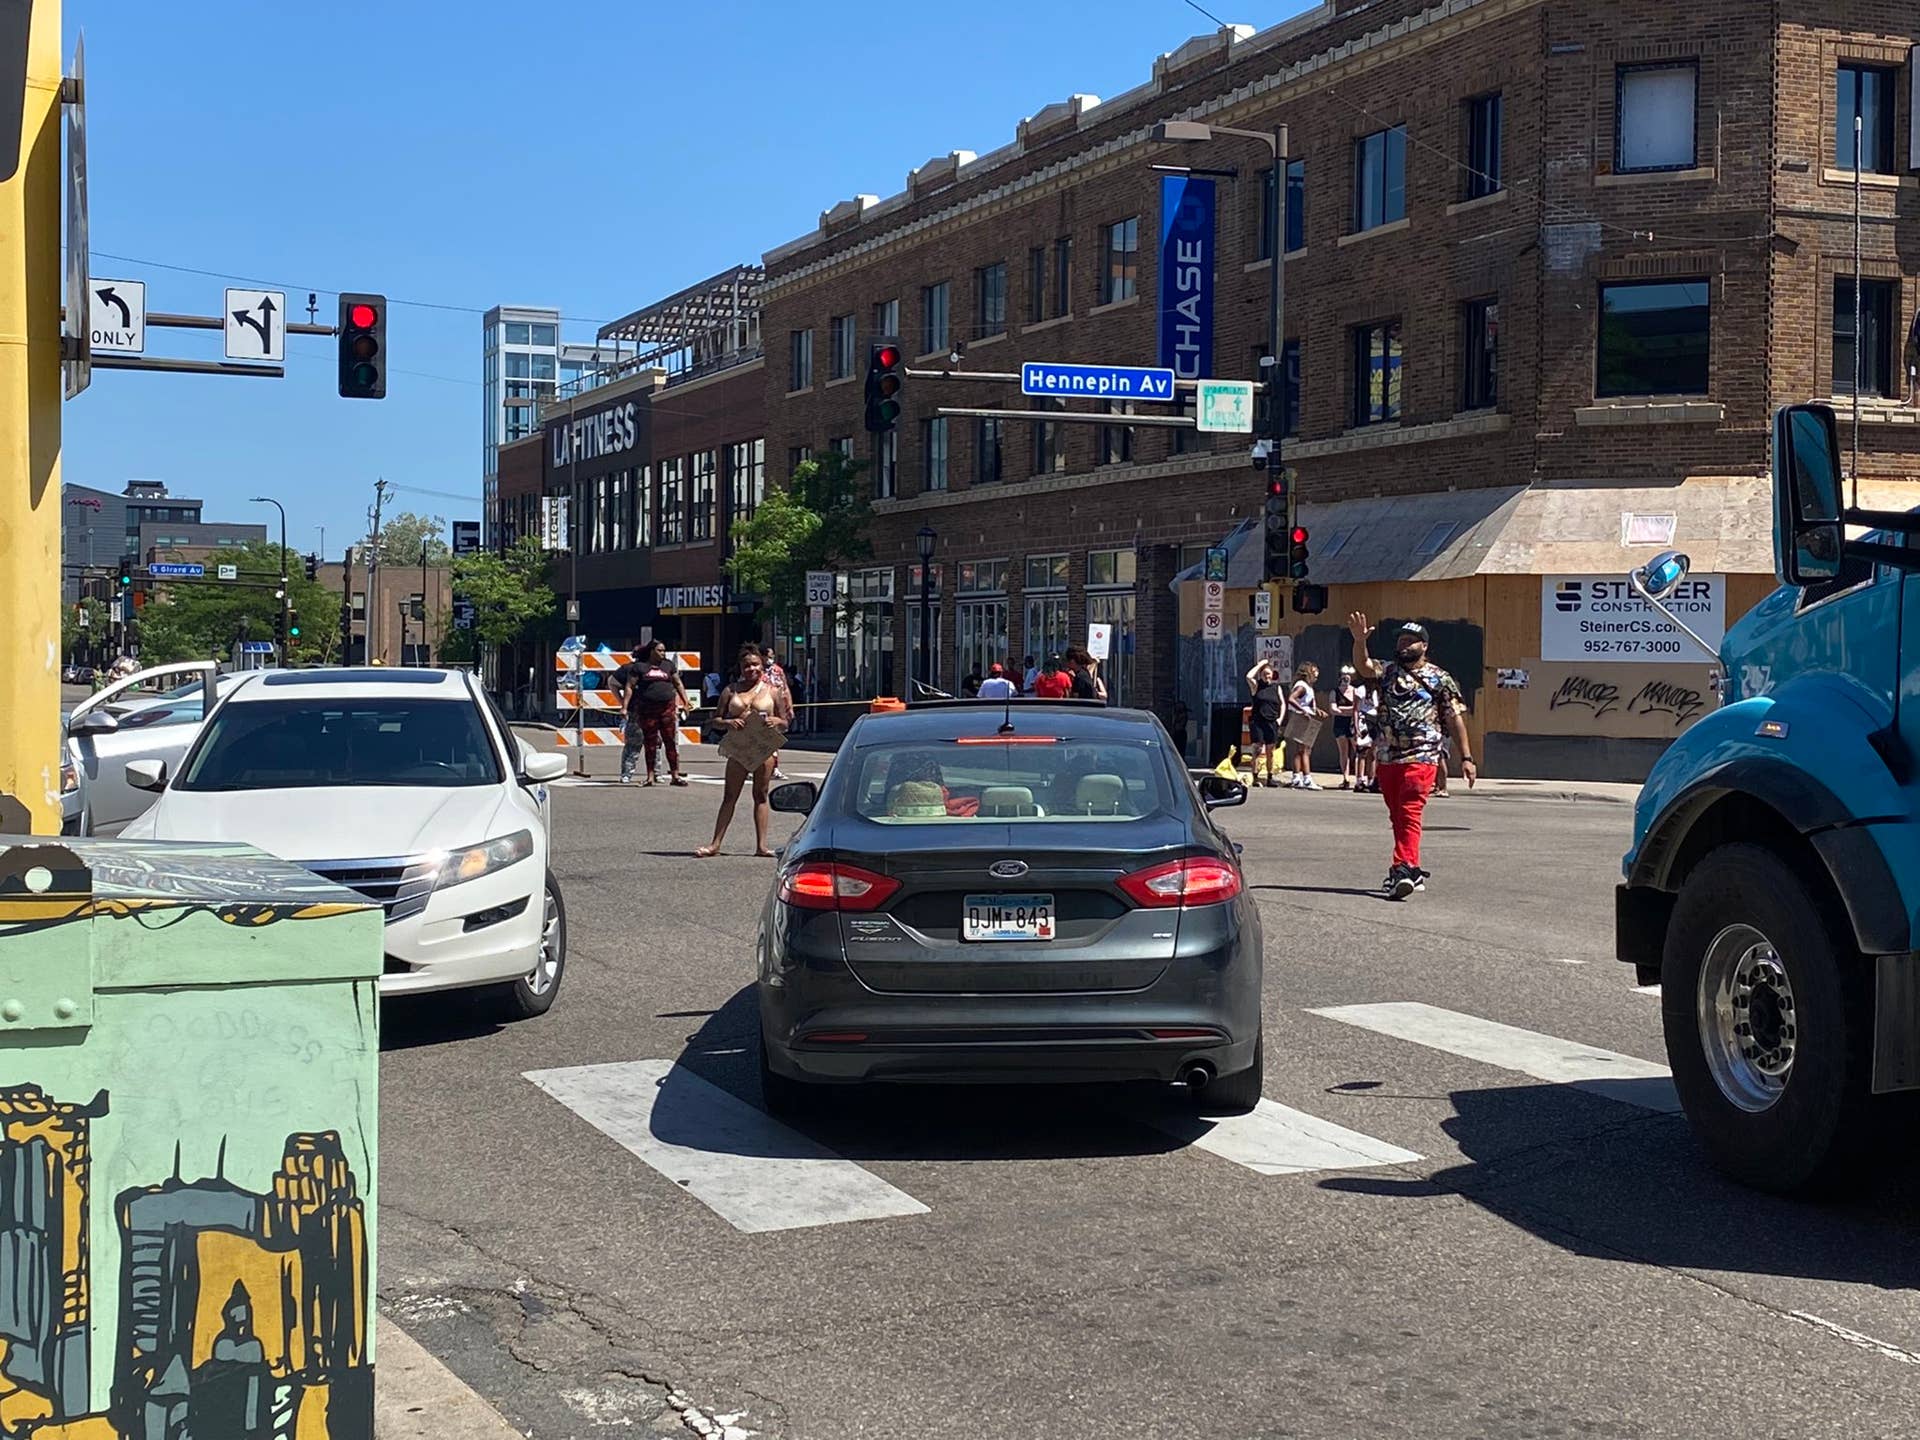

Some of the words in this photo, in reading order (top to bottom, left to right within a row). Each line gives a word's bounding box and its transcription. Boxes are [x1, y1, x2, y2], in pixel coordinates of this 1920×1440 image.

[1175, 238, 1202, 379] CHASE
[91, 330, 135, 346] ONLY
[1029, 370, 1130, 394] Hennepin
[1140, 375, 1167, 393] Av
[553, 424, 570, 469] LA
[573, 402, 635, 463] FITNESS
[190, 565, 201, 574] Av
[809, 589, 830, 602] 30
[1591, 581, 1711, 600] STEER
[656, 587, 672, 608] LA
[1257, 594, 1269, 603] ONE
[1257, 605, 1269, 614] WAY
[1591, 602, 1711, 613] CONSTRCTION
[1265, 638, 1281, 648] NO
[1584, 640, 1681, 653] 952-767-3000
[997, 863, 1020, 874] Ford
[969, 906, 1002, 929] DJM
[1016, 906, 1049, 929] 843
